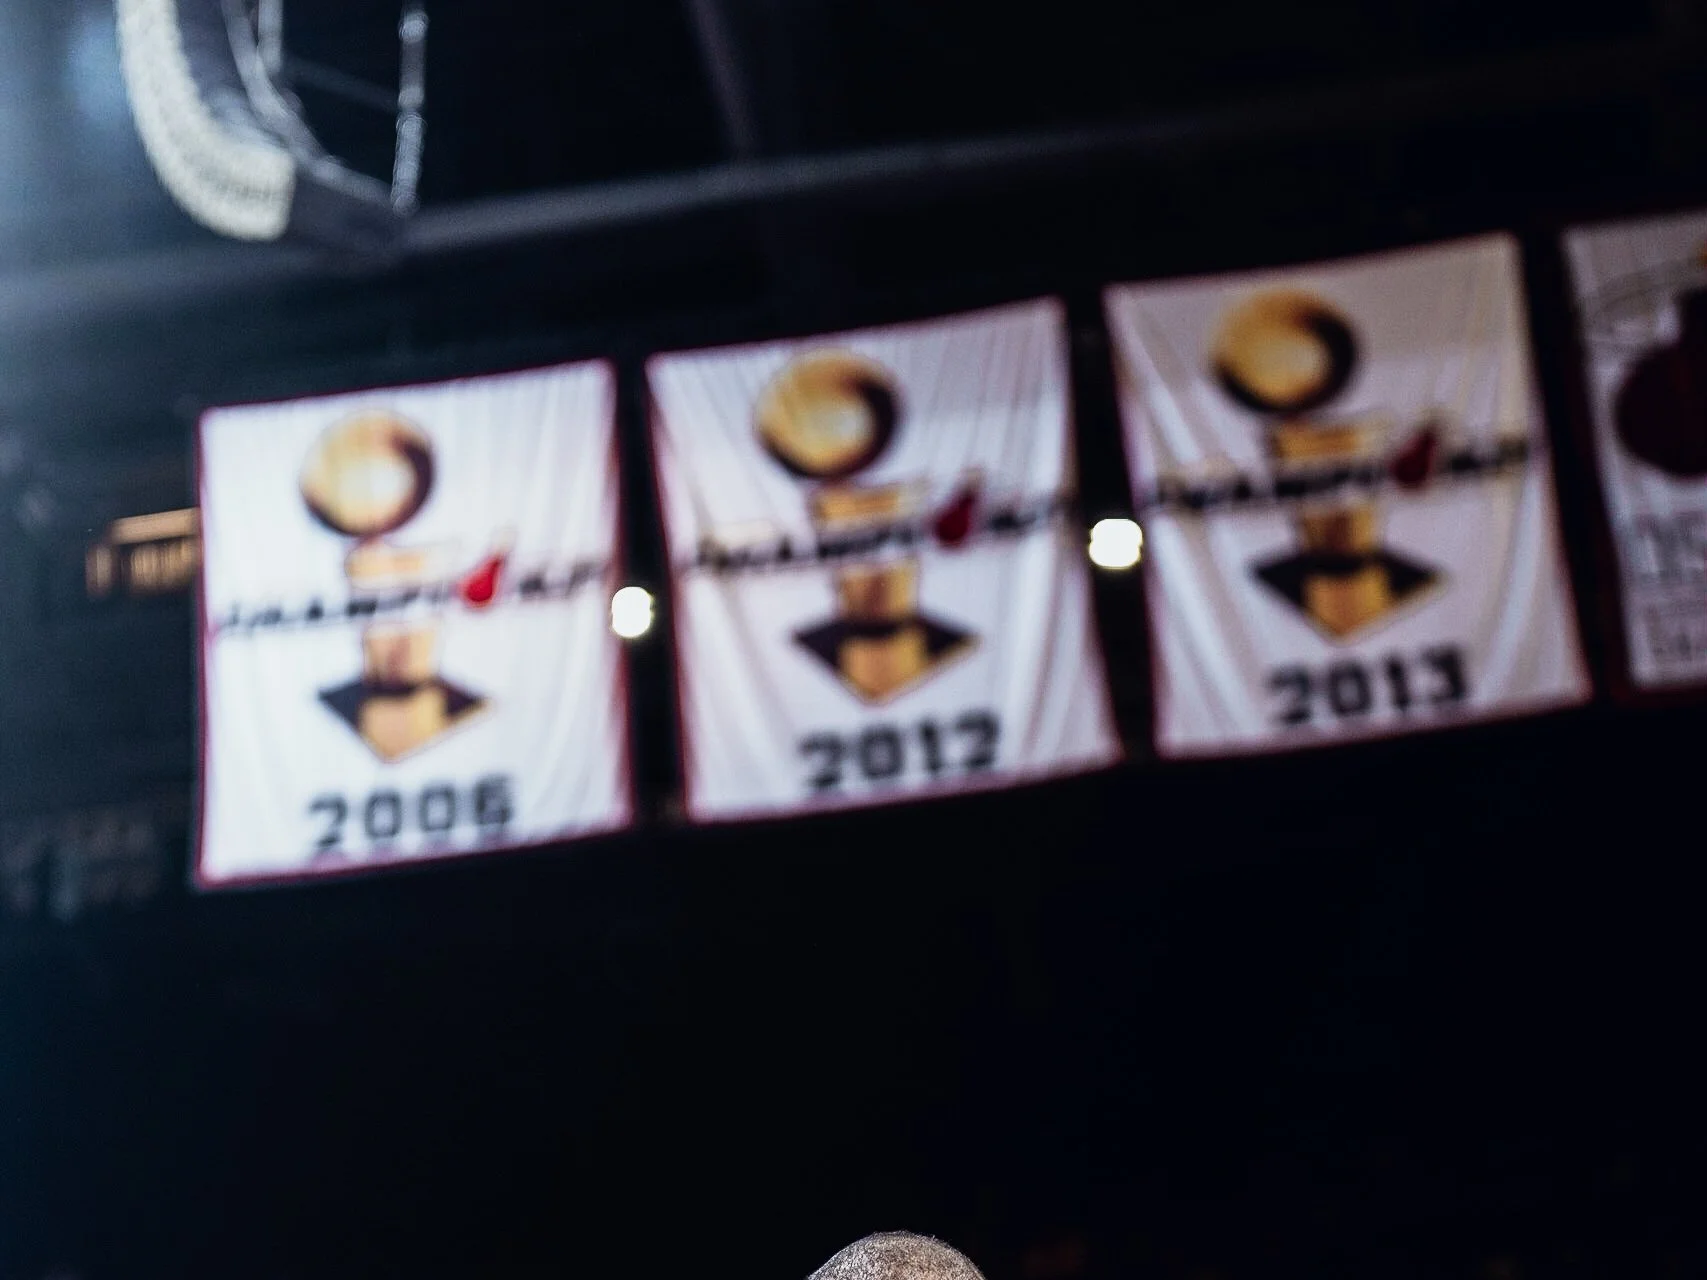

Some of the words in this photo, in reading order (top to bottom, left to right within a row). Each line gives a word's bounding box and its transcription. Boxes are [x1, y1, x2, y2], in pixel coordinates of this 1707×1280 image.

[1267, 648, 1468, 726] 2013
[801, 714, 1000, 788] 2012
[308, 777, 517, 849] 2006
